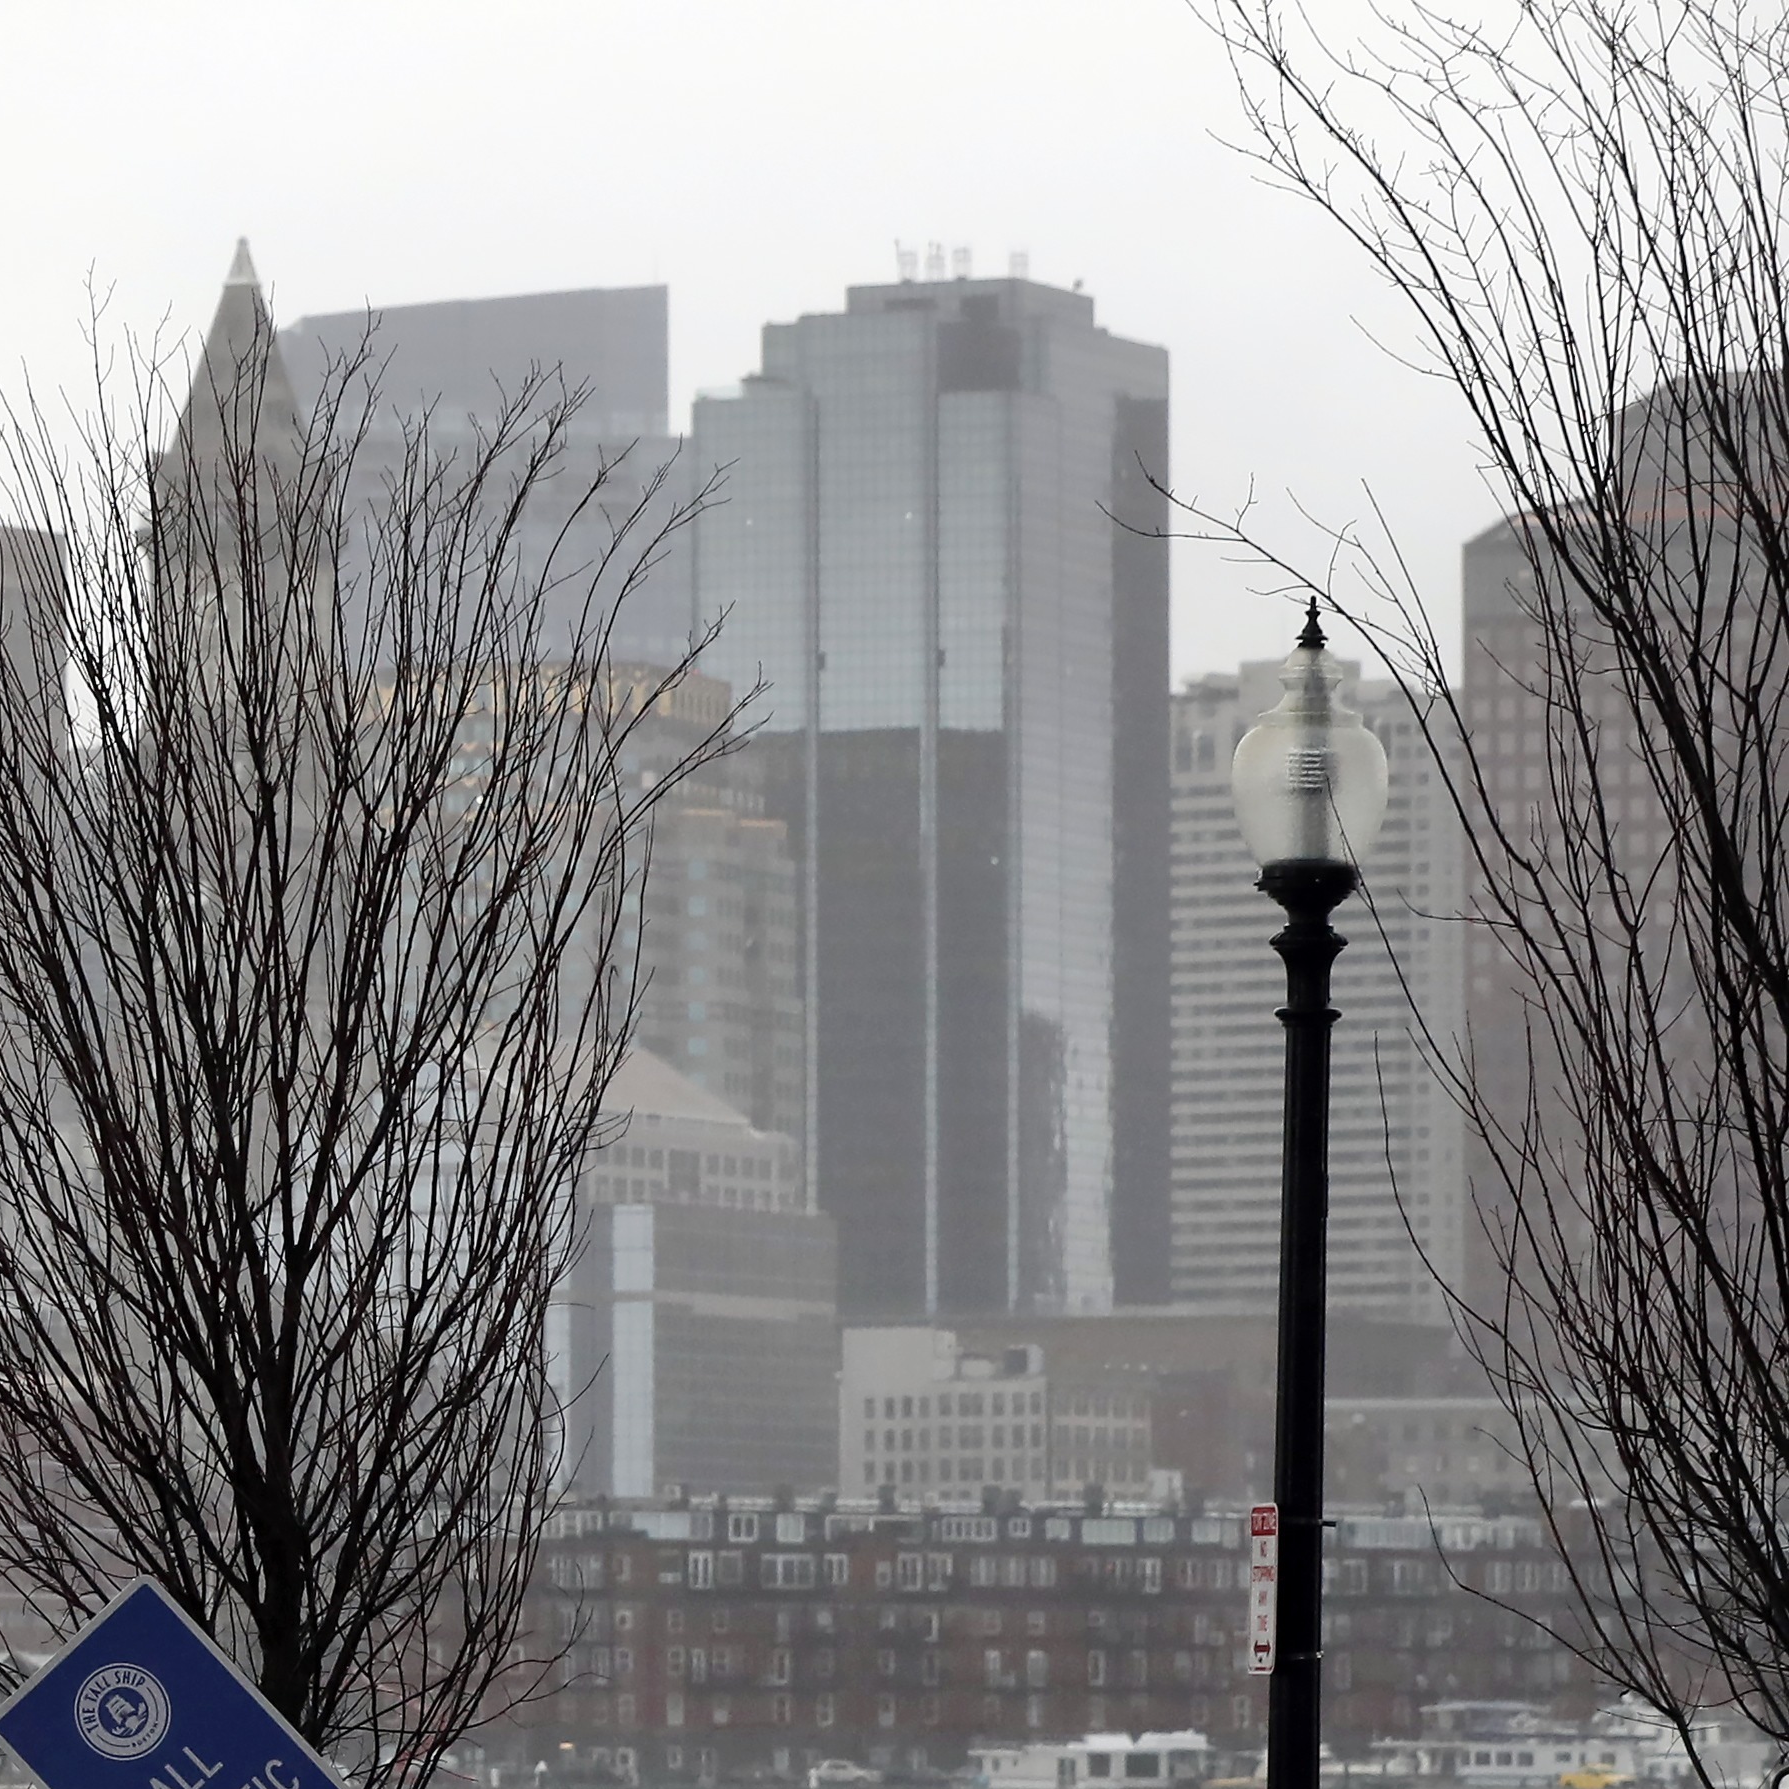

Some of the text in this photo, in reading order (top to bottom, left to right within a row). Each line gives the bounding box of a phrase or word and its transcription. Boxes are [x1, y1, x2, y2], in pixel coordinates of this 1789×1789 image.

[82, 1670, 147, 1734] THE TALL SHIP
